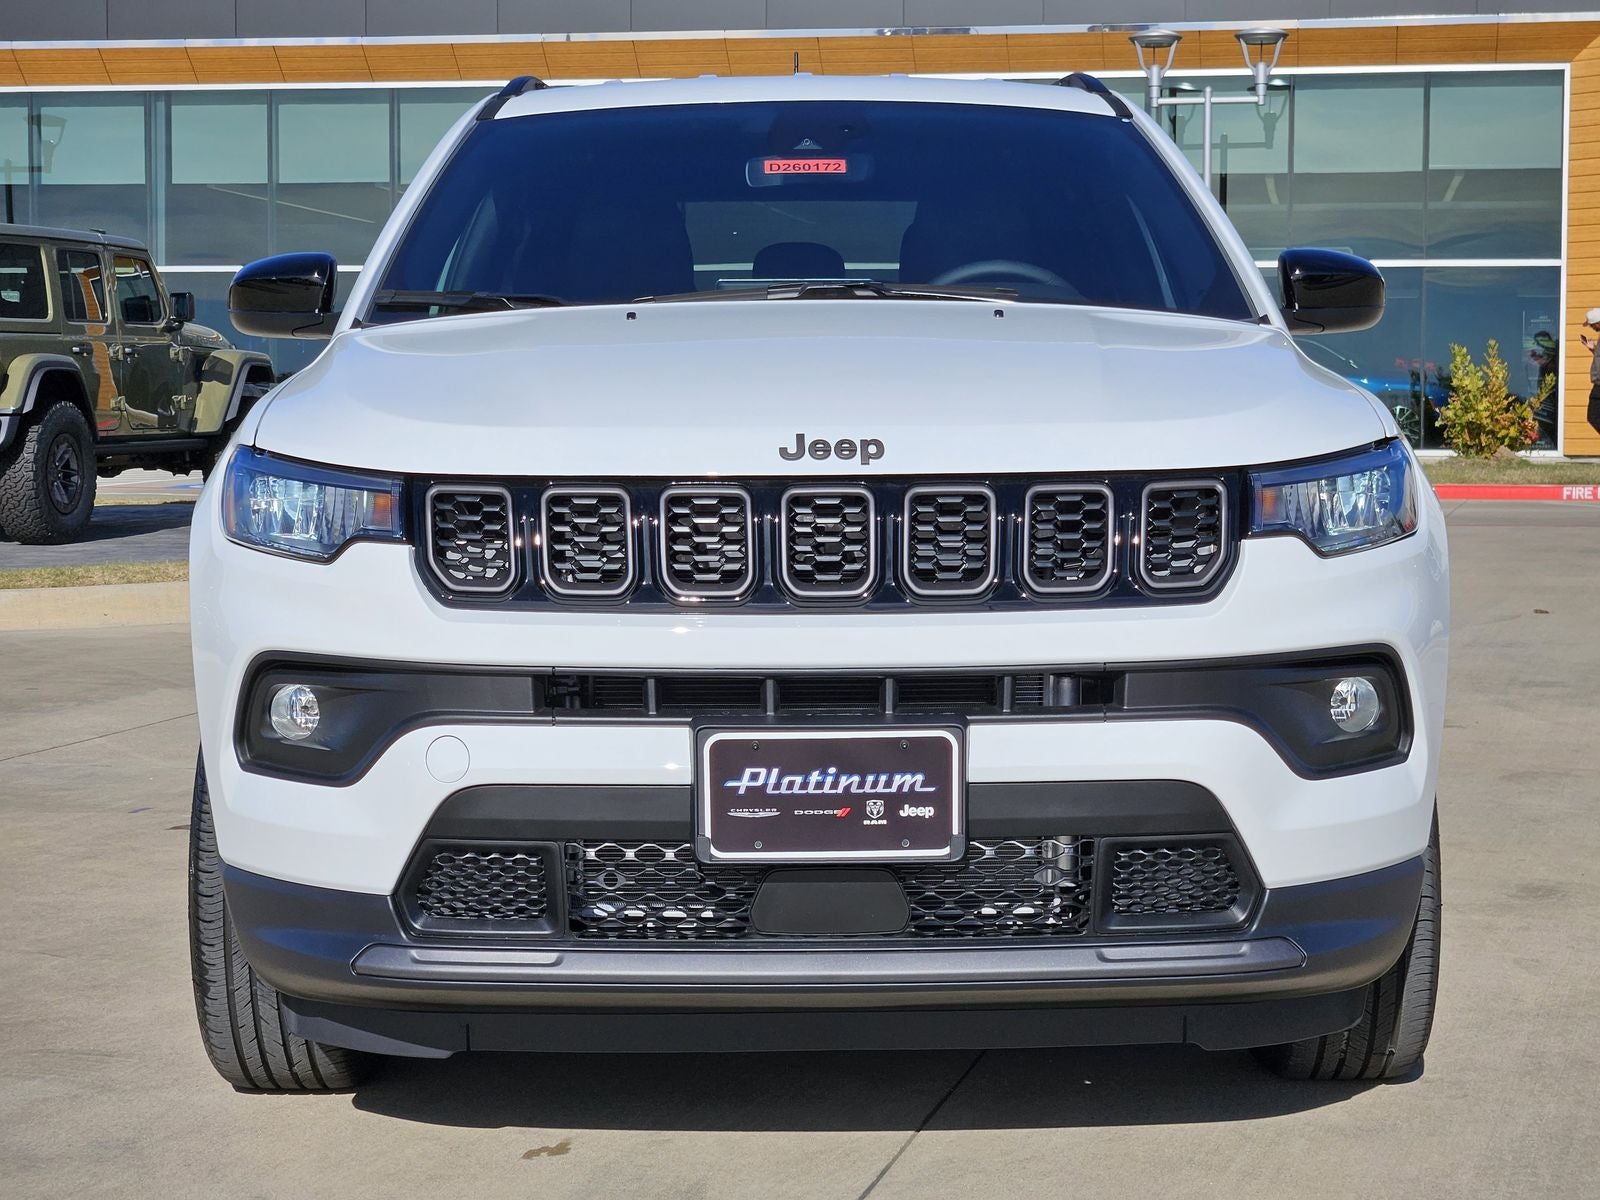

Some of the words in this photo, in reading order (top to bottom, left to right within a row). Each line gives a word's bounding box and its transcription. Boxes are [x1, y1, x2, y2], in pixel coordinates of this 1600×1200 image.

[769, 162, 842, 172] D260172
[779, 433, 885, 465] Jeep
[1563, 486, 1593, 500] FIRE
[723, 766, 937, 796] Platinum
[899, 803, 935, 819] Jeep
